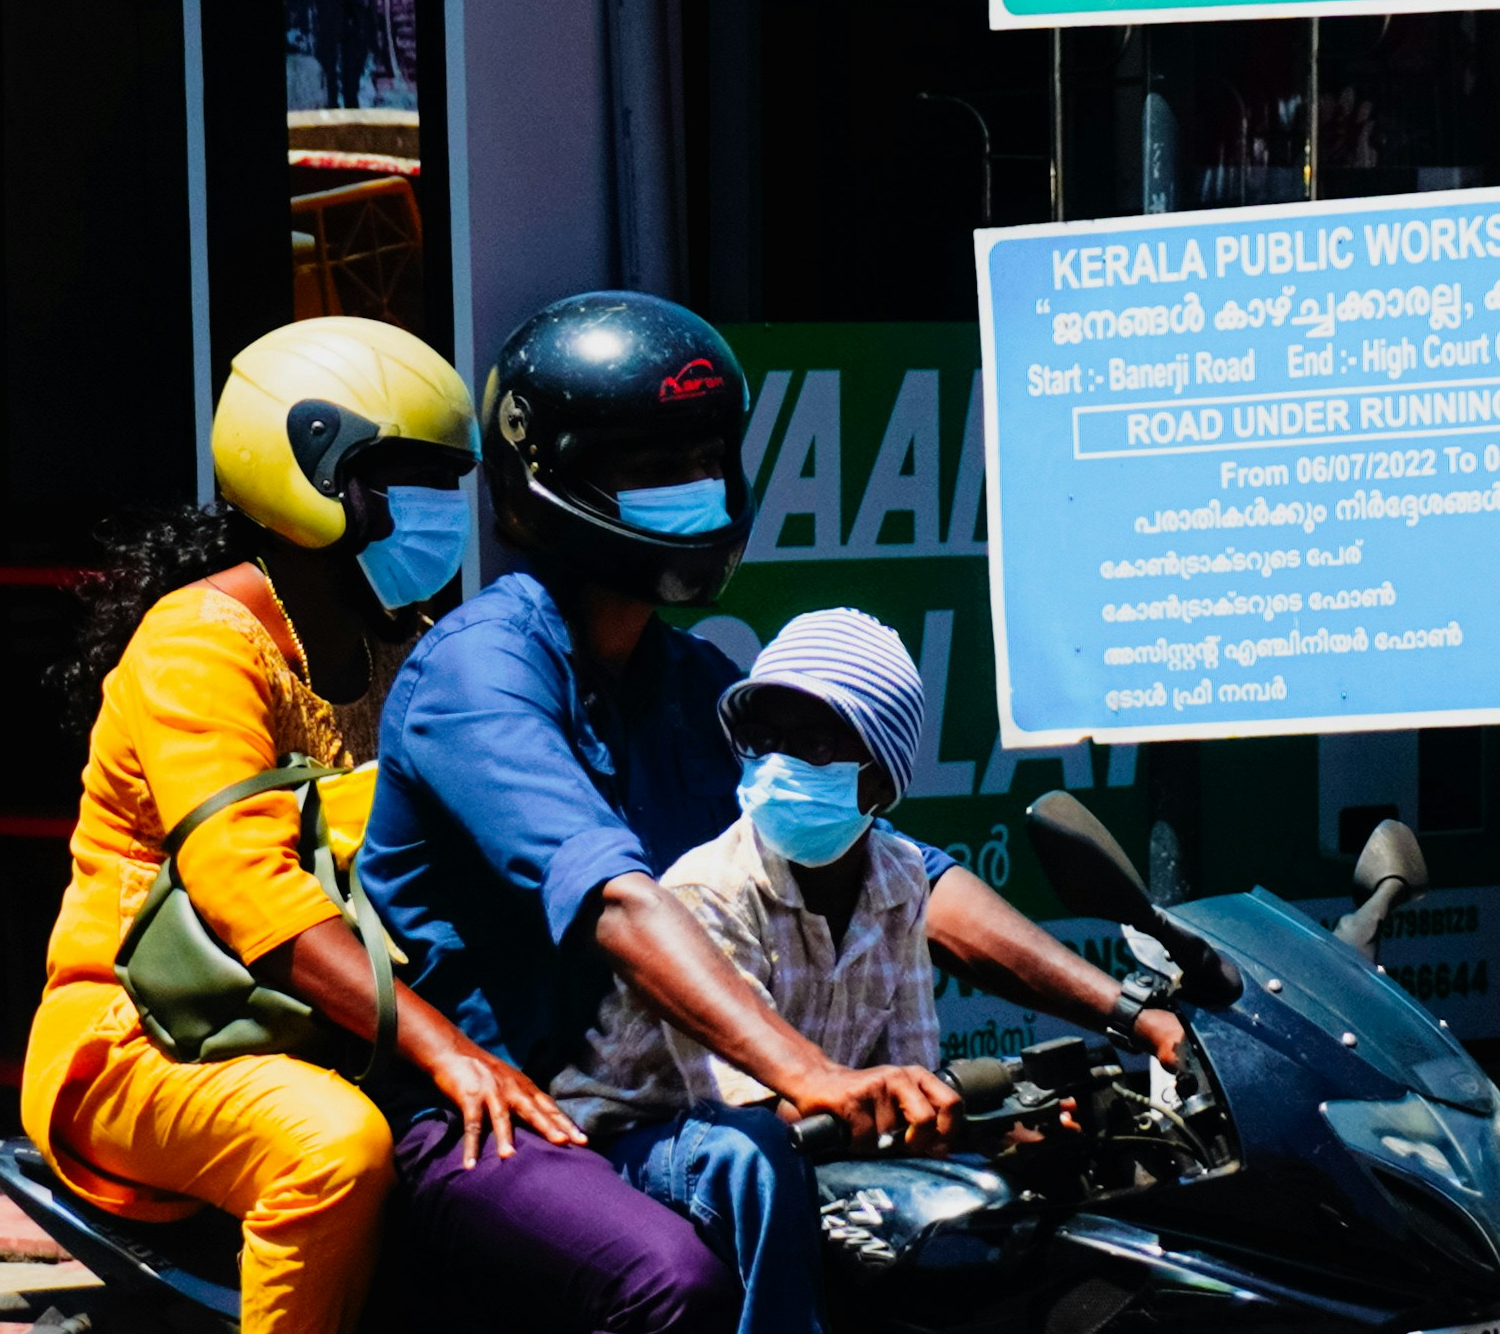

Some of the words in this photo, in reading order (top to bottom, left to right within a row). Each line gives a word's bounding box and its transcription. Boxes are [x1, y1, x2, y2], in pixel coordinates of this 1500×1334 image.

[1053, 239, 1207, 289] KERALA
[1216, 227, 1353, 277] PUBLIC
[1028, 364, 1082, 396] Start
[1109, 354, 1189, 391] Banerji
[1196, 348, 1255, 384] Road
[1288, 343, 1333, 378] End
[1363, 337, 1416, 378] High
[1423, 334, 1490, 368] Court
[1127, 409, 1223, 445] ROAD
[1233, 398, 1350, 439] UNDER
[1221, 462, 1288, 489] From
[1297, 449, 1436, 483] 06/07/2022
[1444, 447, 1477, 473] To
